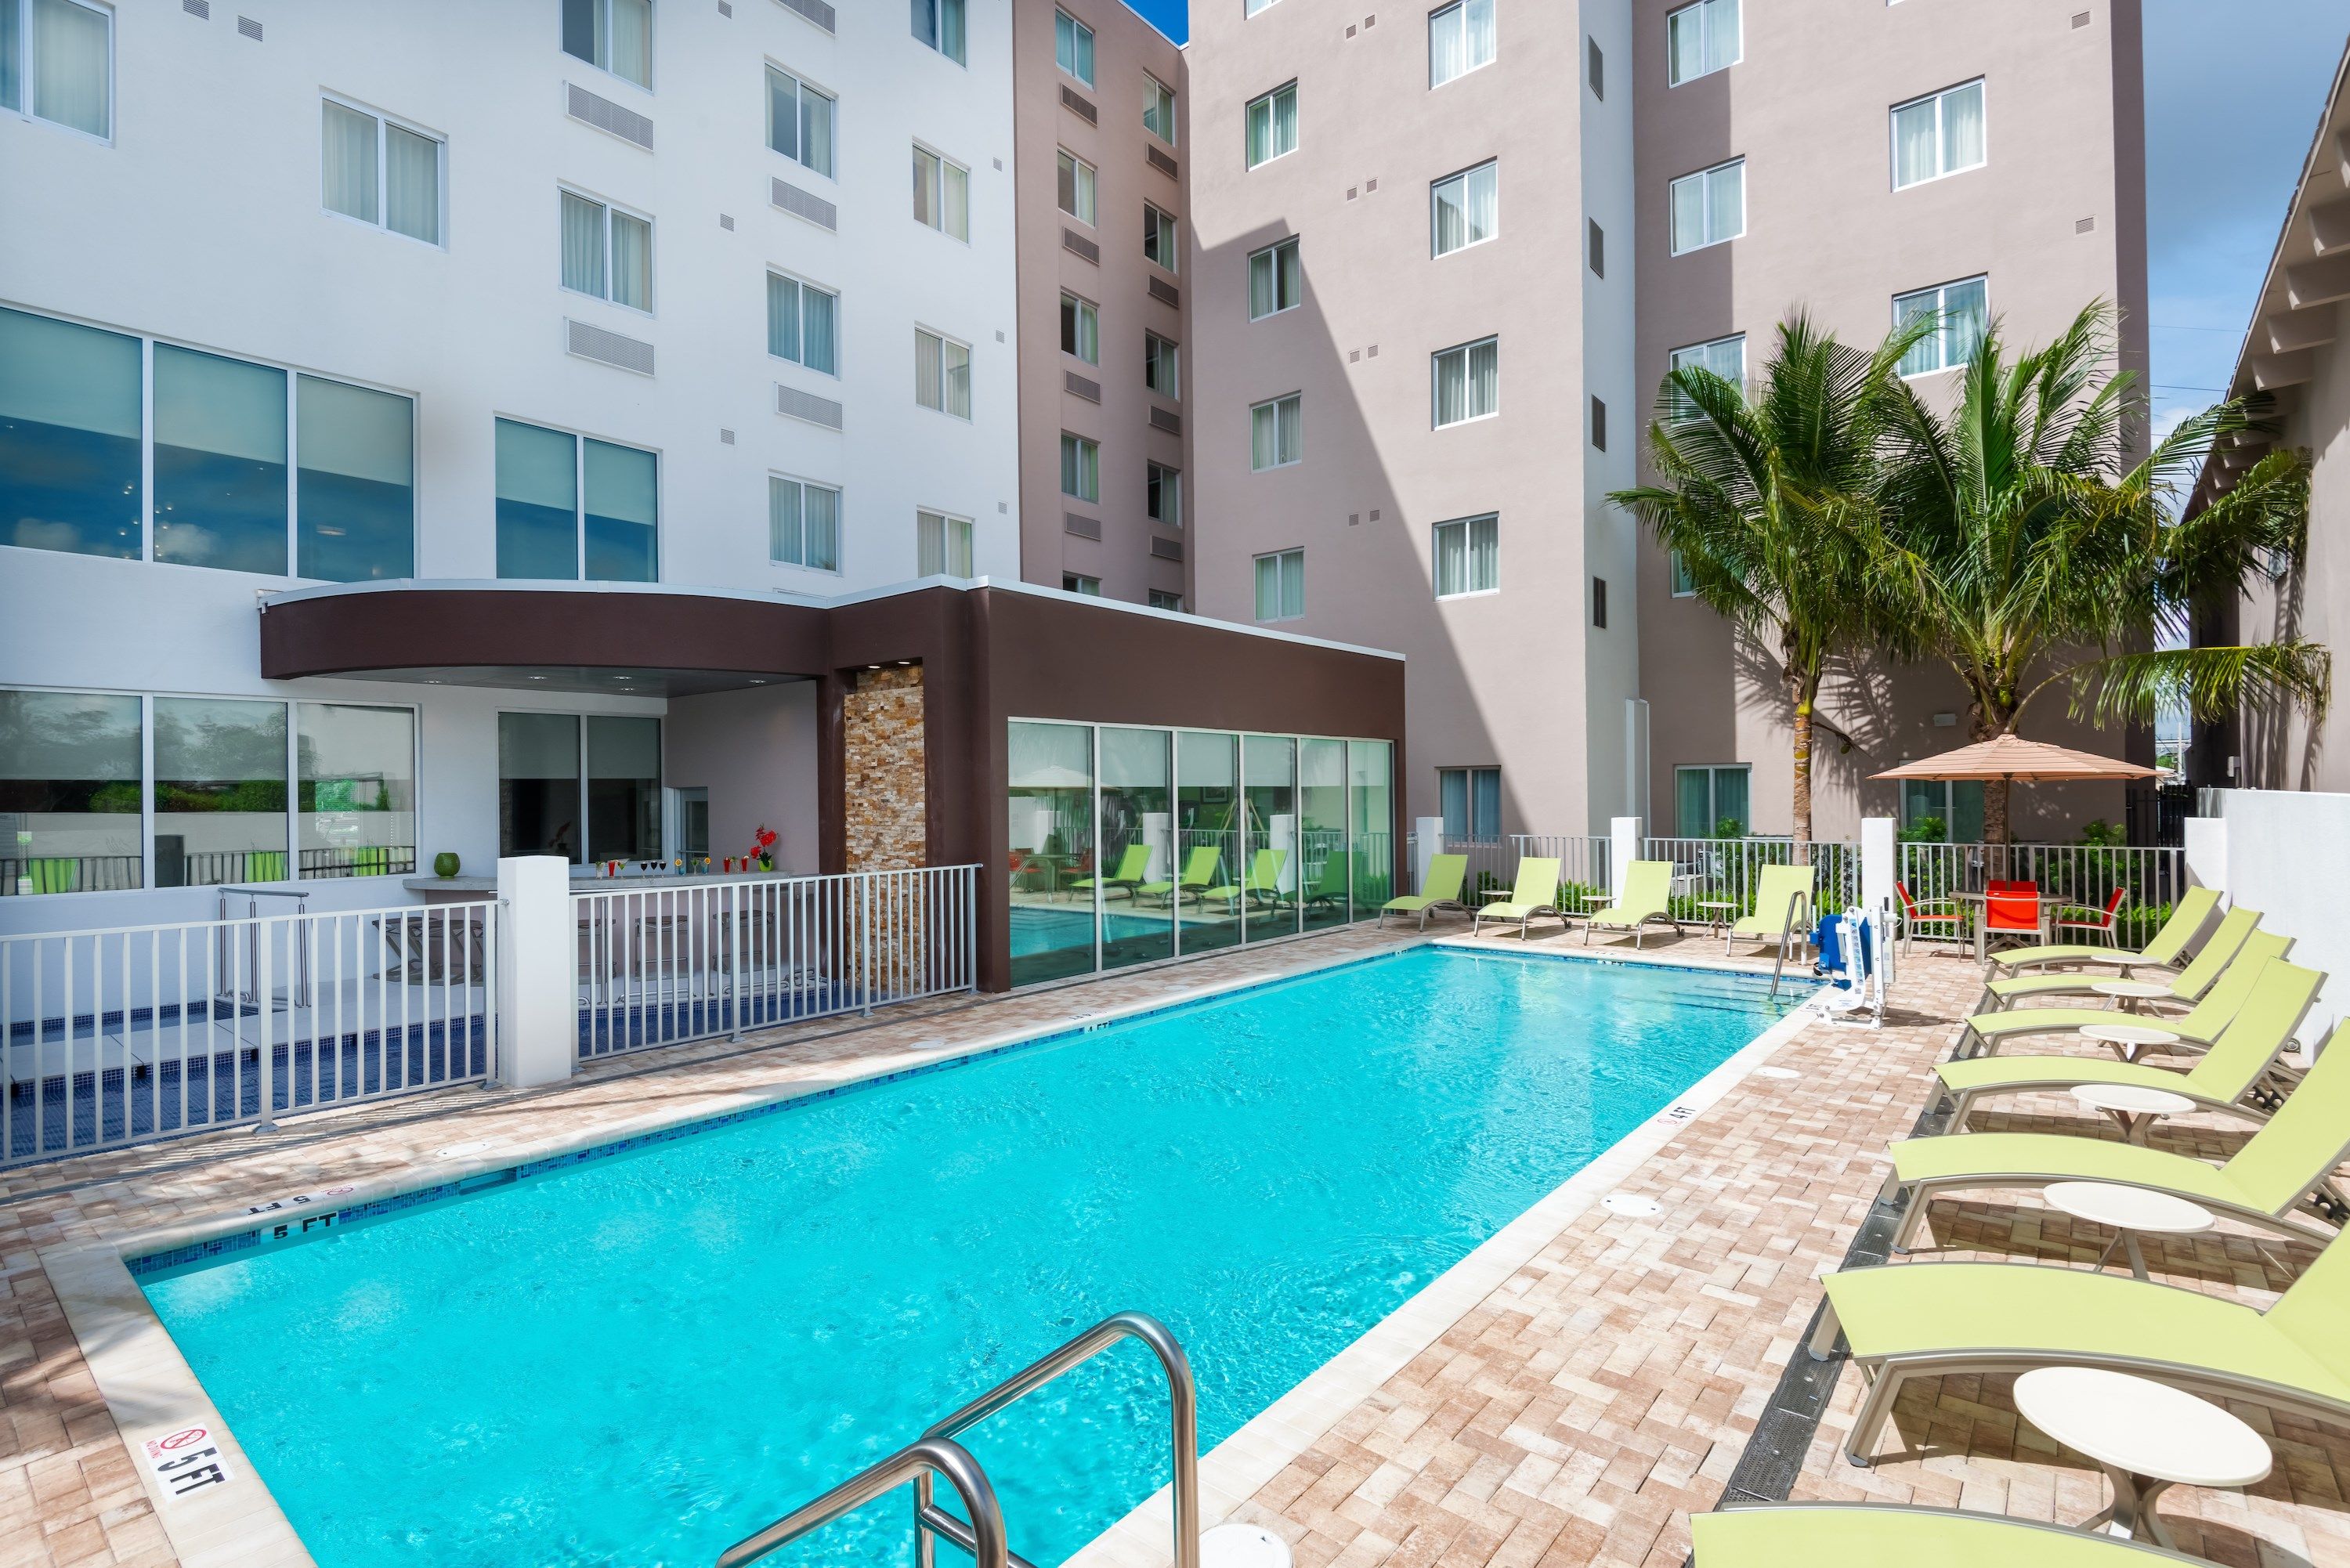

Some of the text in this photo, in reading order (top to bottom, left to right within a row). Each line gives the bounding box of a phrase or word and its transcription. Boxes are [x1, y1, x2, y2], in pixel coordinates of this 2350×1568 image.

[248, 1195, 311, 1216] 5 FT
[274, 1212, 337, 1239] 5 FT
[157, 1447, 226, 1495] 5 FT
